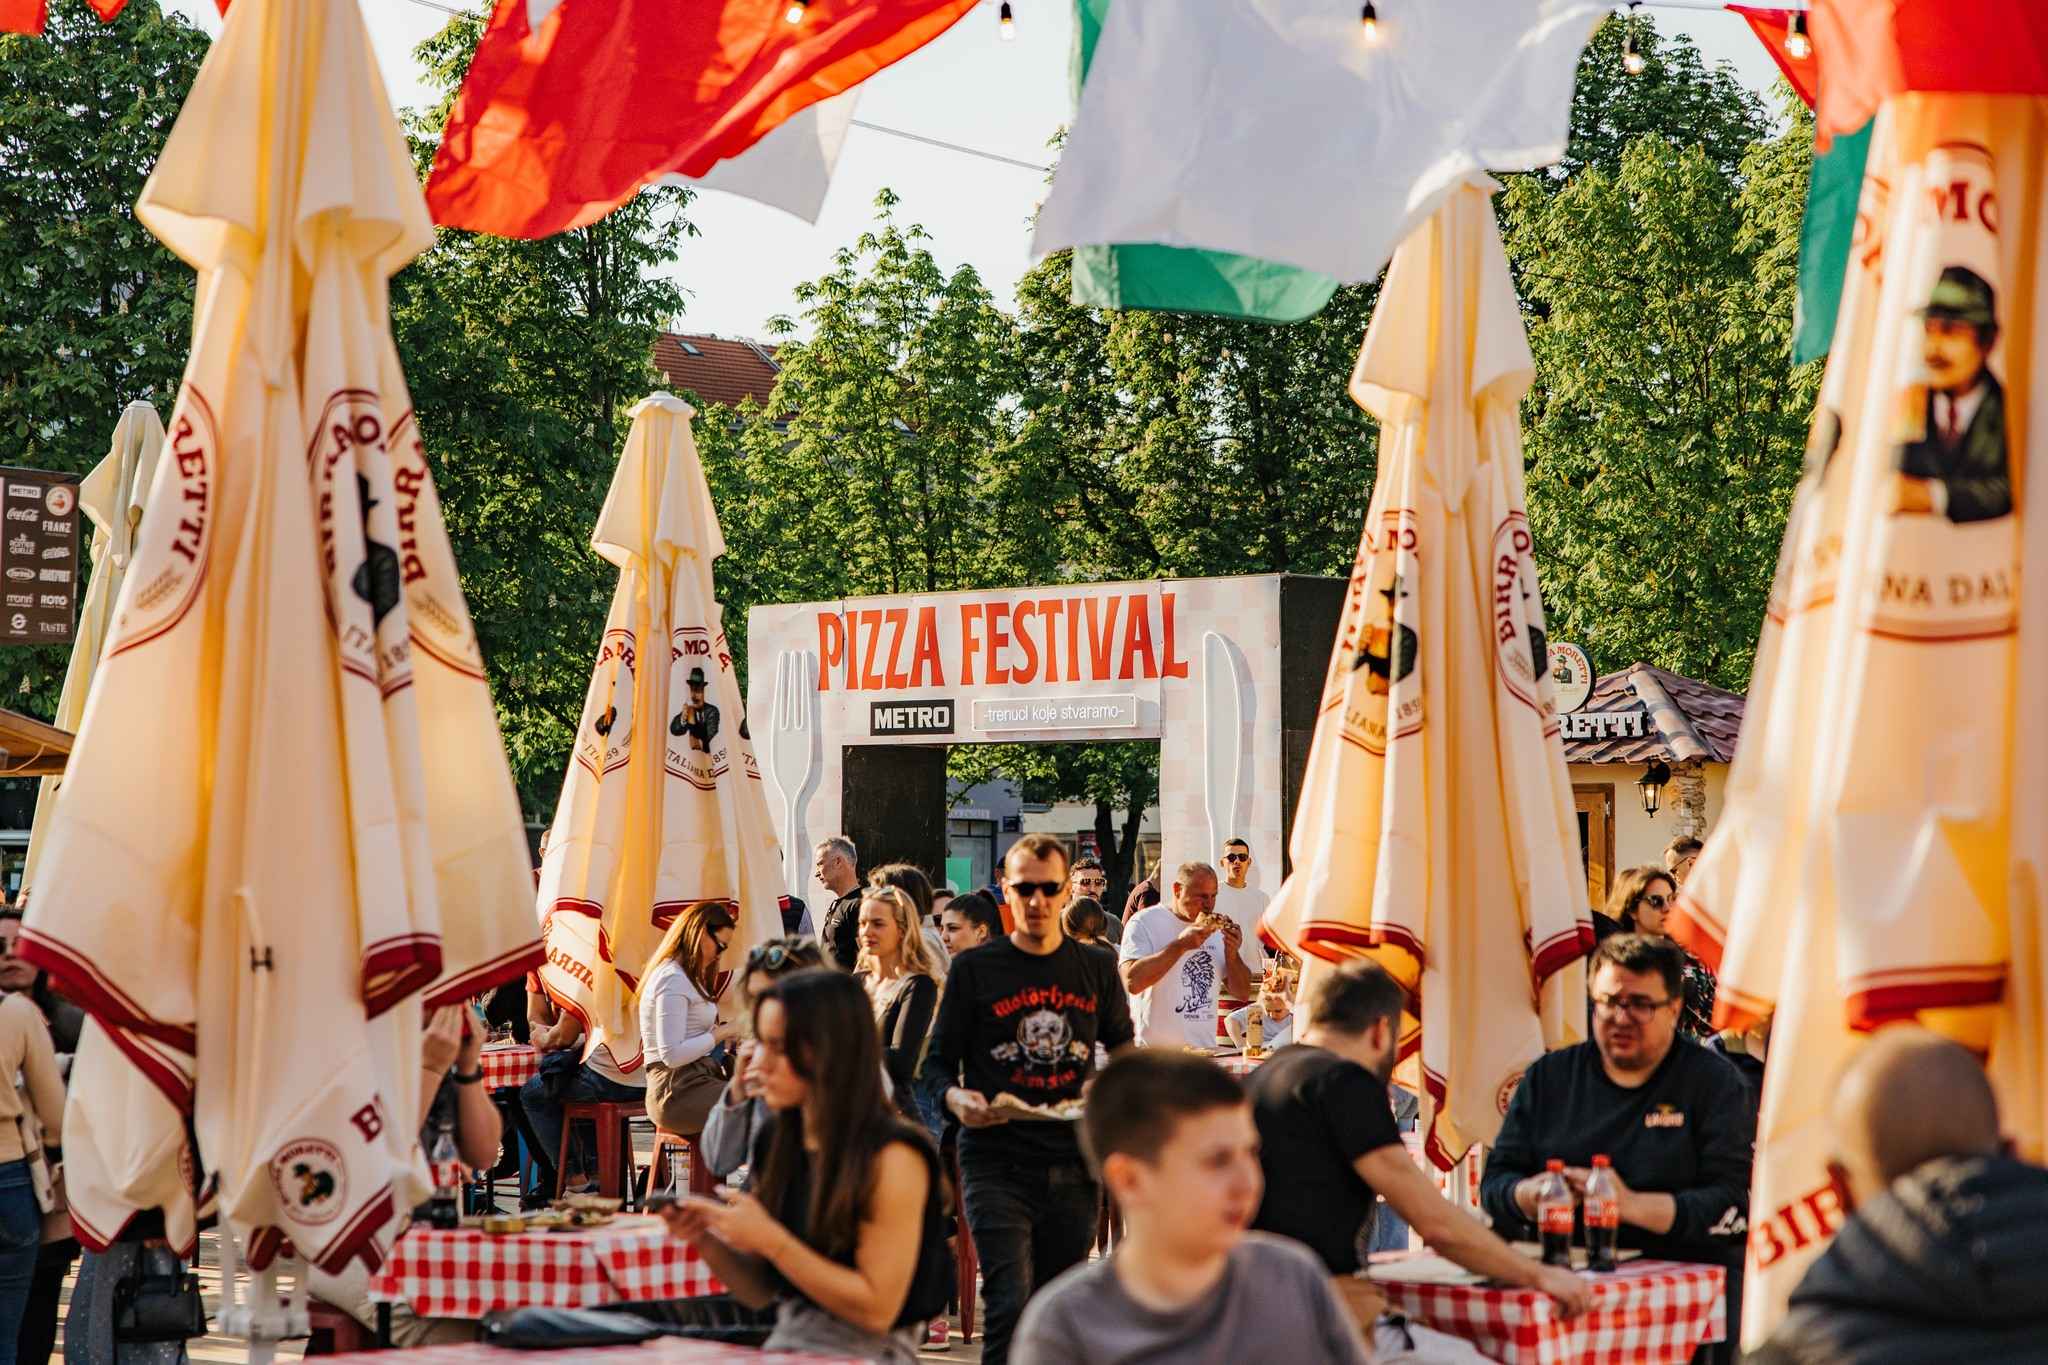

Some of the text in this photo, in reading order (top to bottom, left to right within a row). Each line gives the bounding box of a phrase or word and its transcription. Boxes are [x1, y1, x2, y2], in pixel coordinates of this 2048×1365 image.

[817, 593, 1189, 691] PIZZA FESTIVAL
[874, 706, 950, 730] METRO
[1032, 702, 1057, 723] koje
[1061, 703, 1125, 720] stvaramo-
